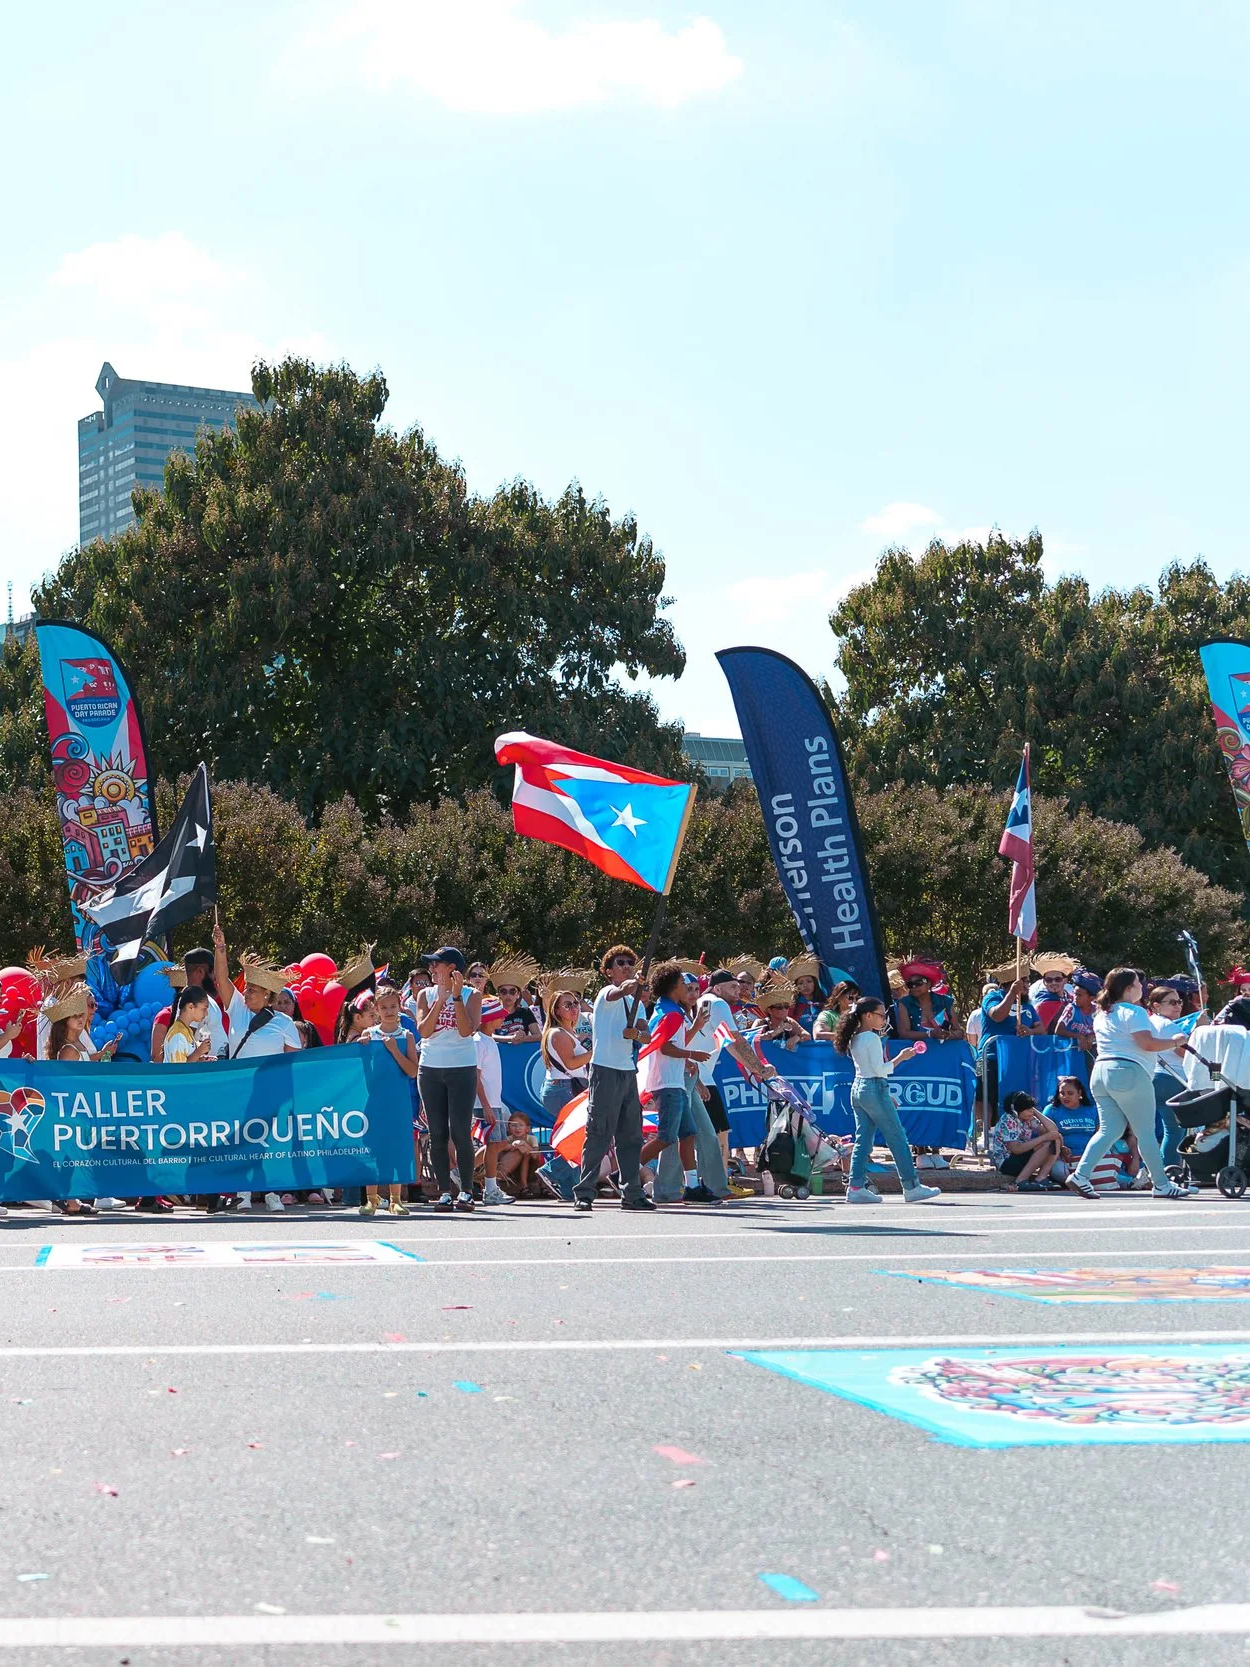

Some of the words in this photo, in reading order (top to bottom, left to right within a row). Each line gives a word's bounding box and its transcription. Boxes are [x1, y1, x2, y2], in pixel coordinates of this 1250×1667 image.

[89, 709, 116, 717] PARADE
[97, 702, 118, 710] RICAN
[805, 735, 842, 829] Plans
[814, 834, 864, 950] Health
[51, 1089, 167, 1118] TALLER
[53, 1106, 369, 1151] PUERTORRIQUEÑO
[62, 1159, 101, 1168] CORAZÓN
[102, 1158, 141, 1167] CULTURAL
[143, 1157, 157, 1165] DEL
[158, 1156, 187, 1165] BARRIO
[193, 1155, 207, 1163] THE
[208, 1154, 248, 1163] CULTURAL
[249, 1151, 273, 1160] HEART
[275, 1151, 285, 1159] OF
[287, 1149, 316, 1158] LATINO
[317, 1147, 370, 1157] PHILADELPHIA
